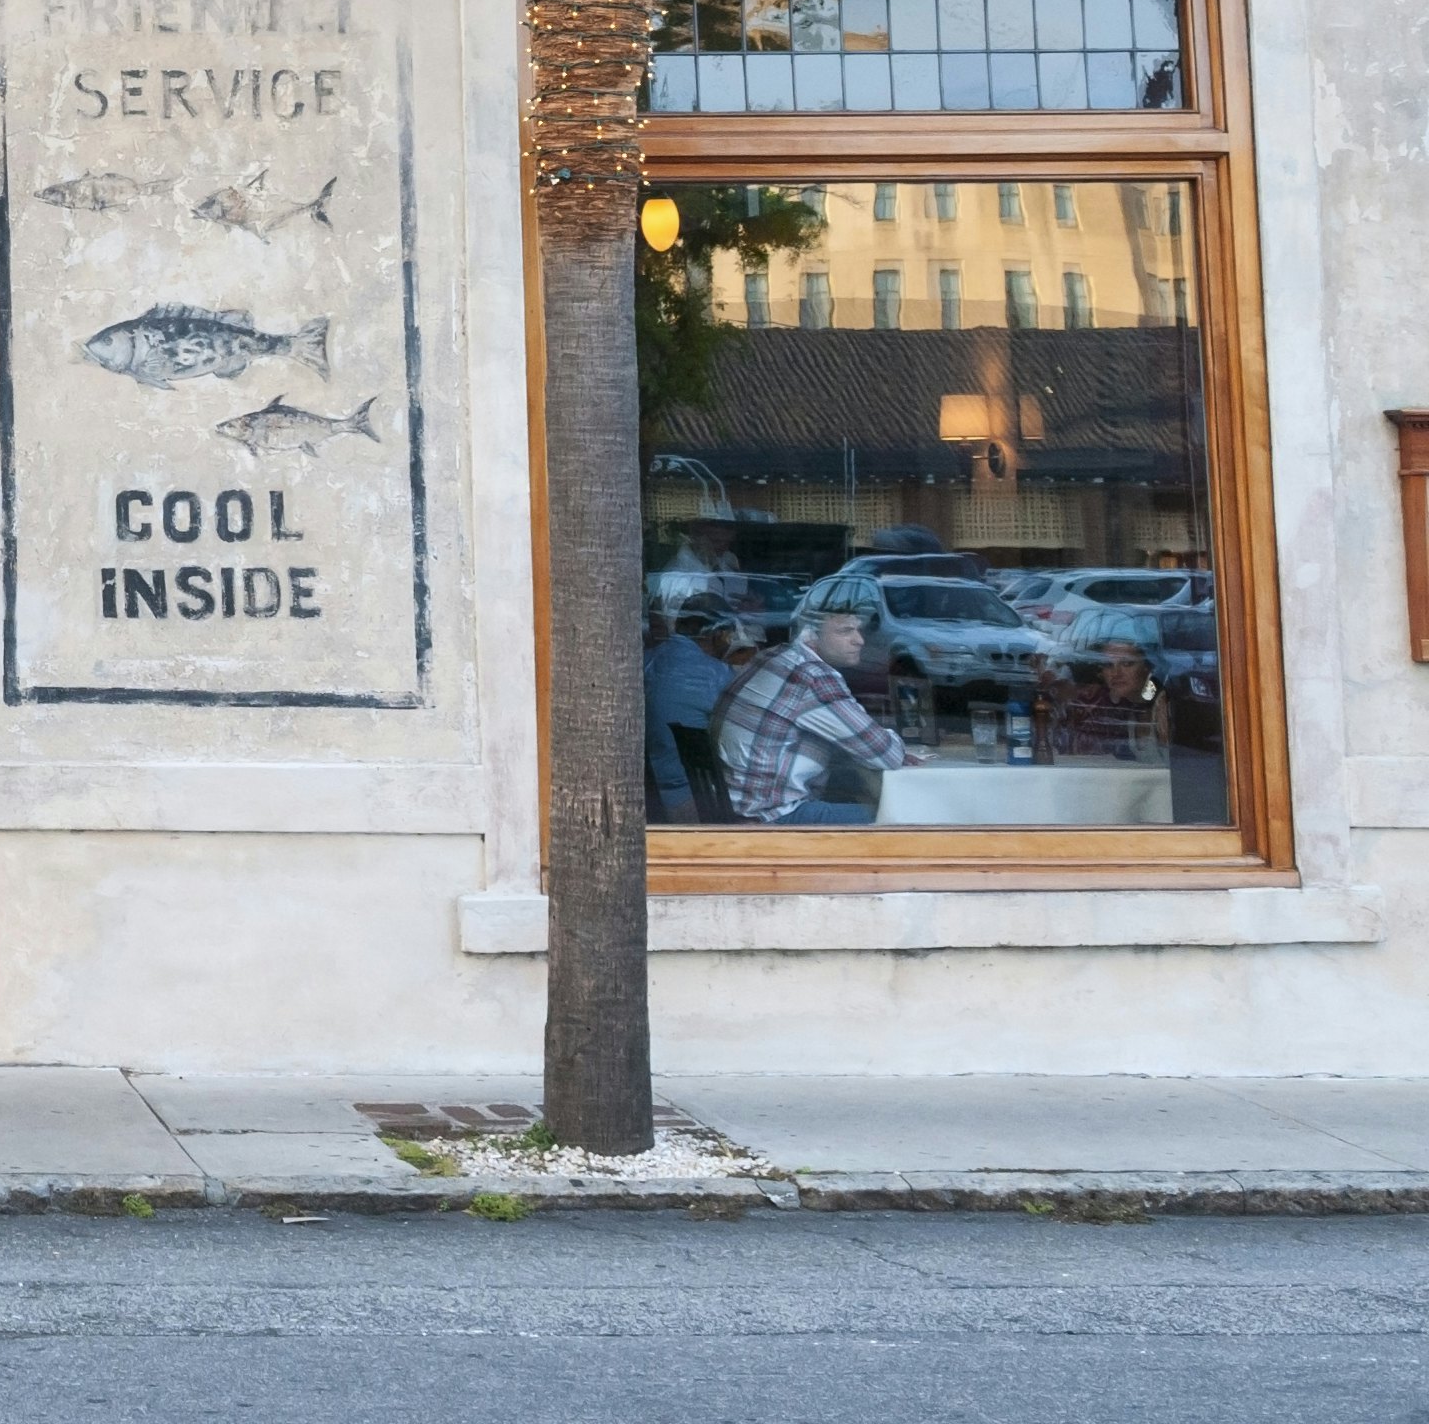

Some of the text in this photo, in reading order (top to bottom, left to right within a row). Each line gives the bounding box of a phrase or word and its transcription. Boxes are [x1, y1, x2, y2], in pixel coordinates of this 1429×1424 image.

[74, 69, 342, 120] SERVICE
[115, 490, 305, 543] COOL
[101, 566, 323, 621] INSIDE
